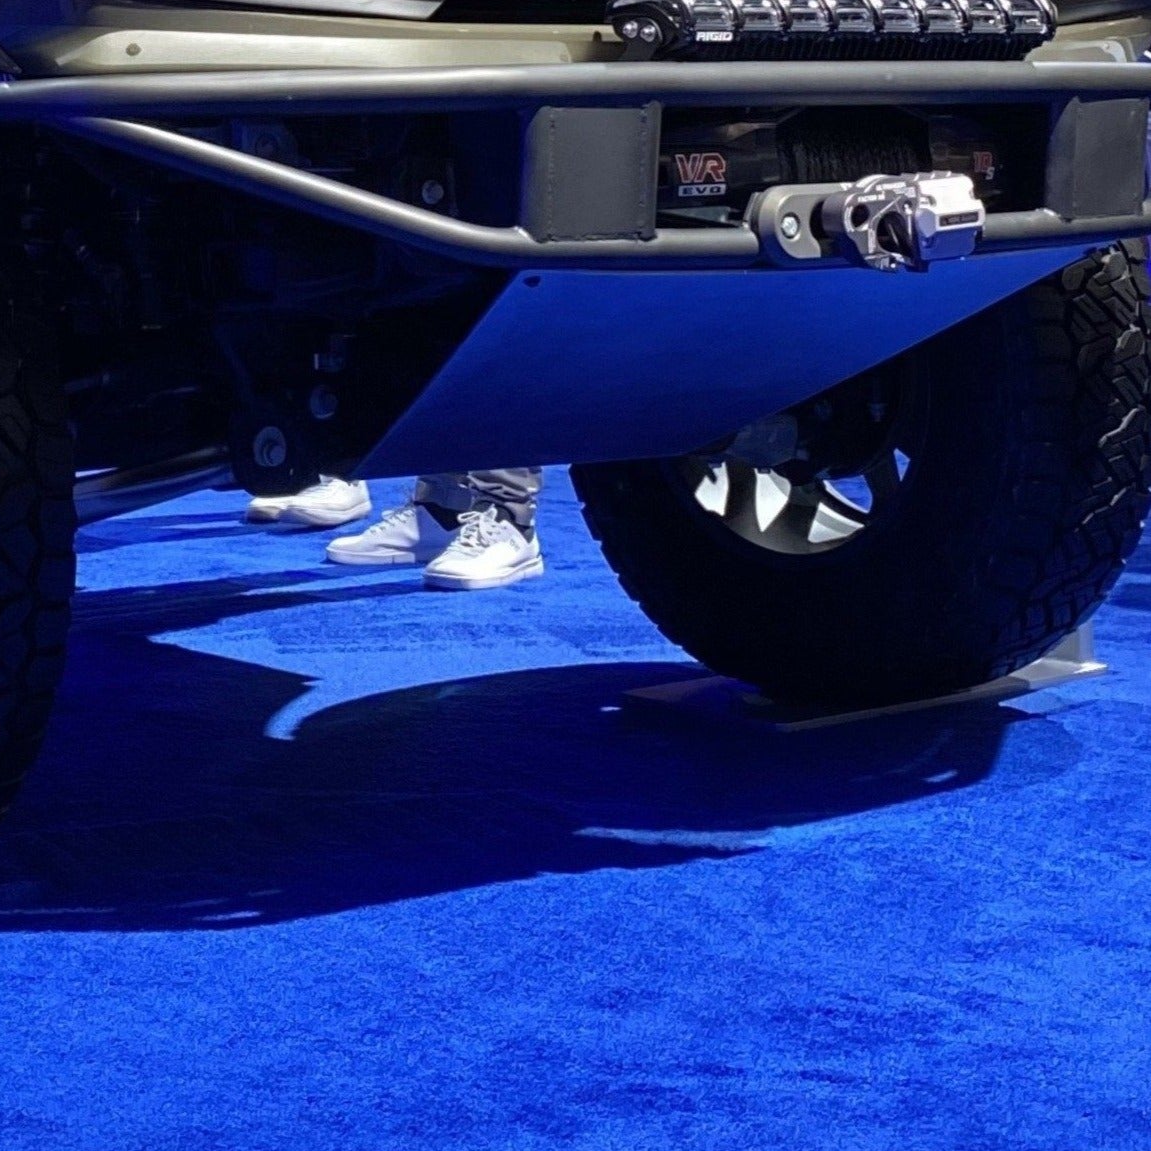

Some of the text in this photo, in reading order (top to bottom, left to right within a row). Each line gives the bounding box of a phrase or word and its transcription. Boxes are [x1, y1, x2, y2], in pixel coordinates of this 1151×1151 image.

[695, 31, 733, 42] RIGID
[674, 152, 726, 183] VR
[680, 185, 724, 196] EVO
